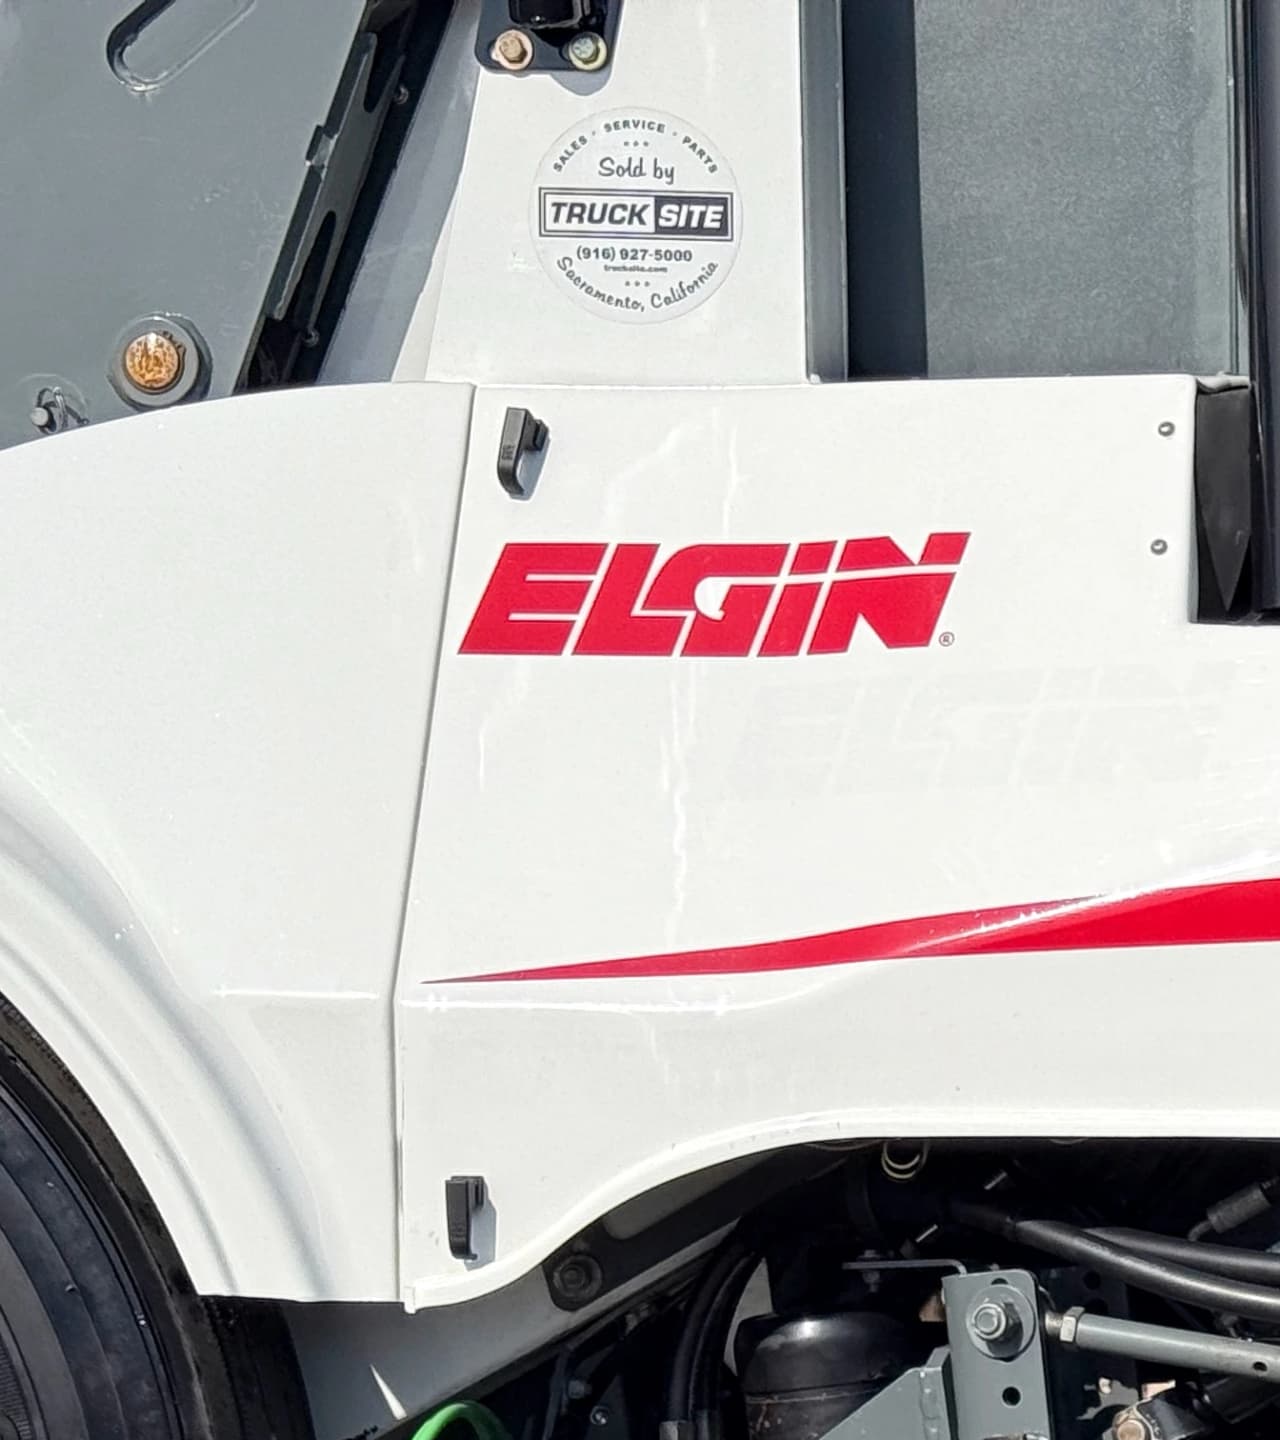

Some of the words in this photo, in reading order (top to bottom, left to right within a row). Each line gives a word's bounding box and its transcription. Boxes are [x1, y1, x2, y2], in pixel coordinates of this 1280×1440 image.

[553, 135, 588, 172] SALES
[603, 119, 666, 133] SERVICE
[682, 135, 718, 174] PARTS
[598, 156, 646, 178] Sold
[653, 157, 675, 185] by
[551, 202, 650, 225] TRUCK
[658, 204, 724, 229] SITE
[576, 246, 616, 262] (916)
[620, 248, 692, 262] 927-5000
[557, 256, 645, 313] Sacramento,
[651, 261, 718, 309] California
[458, 532, 971, 656] ELGIN
